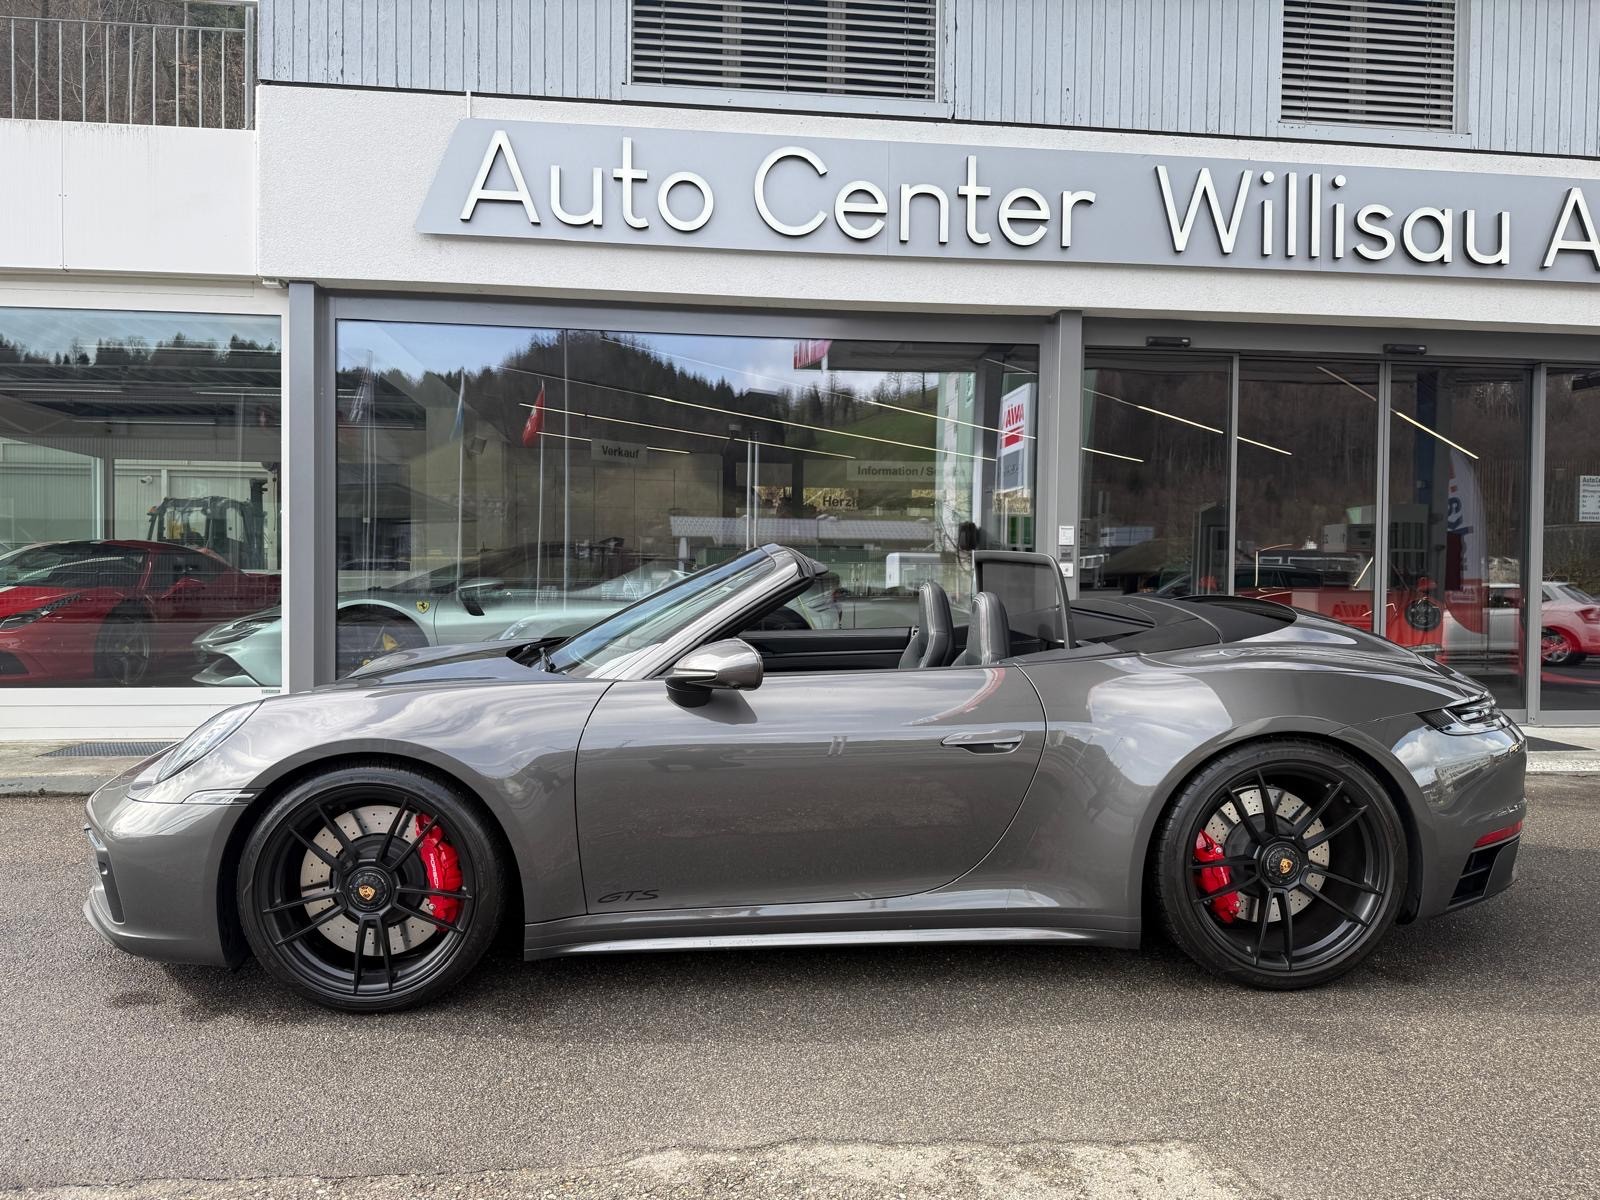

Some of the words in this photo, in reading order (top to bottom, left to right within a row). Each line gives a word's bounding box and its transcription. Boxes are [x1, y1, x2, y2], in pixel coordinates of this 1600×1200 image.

[460, 130, 715, 232] Auto
[754, 146, 1097, 248] Center
[1154, 165, 1510, 266] Willisau
[602, 445, 640, 459] Verkauf
[857, 465, 919, 477] Information
[597, 889, 660, 903] GTS
